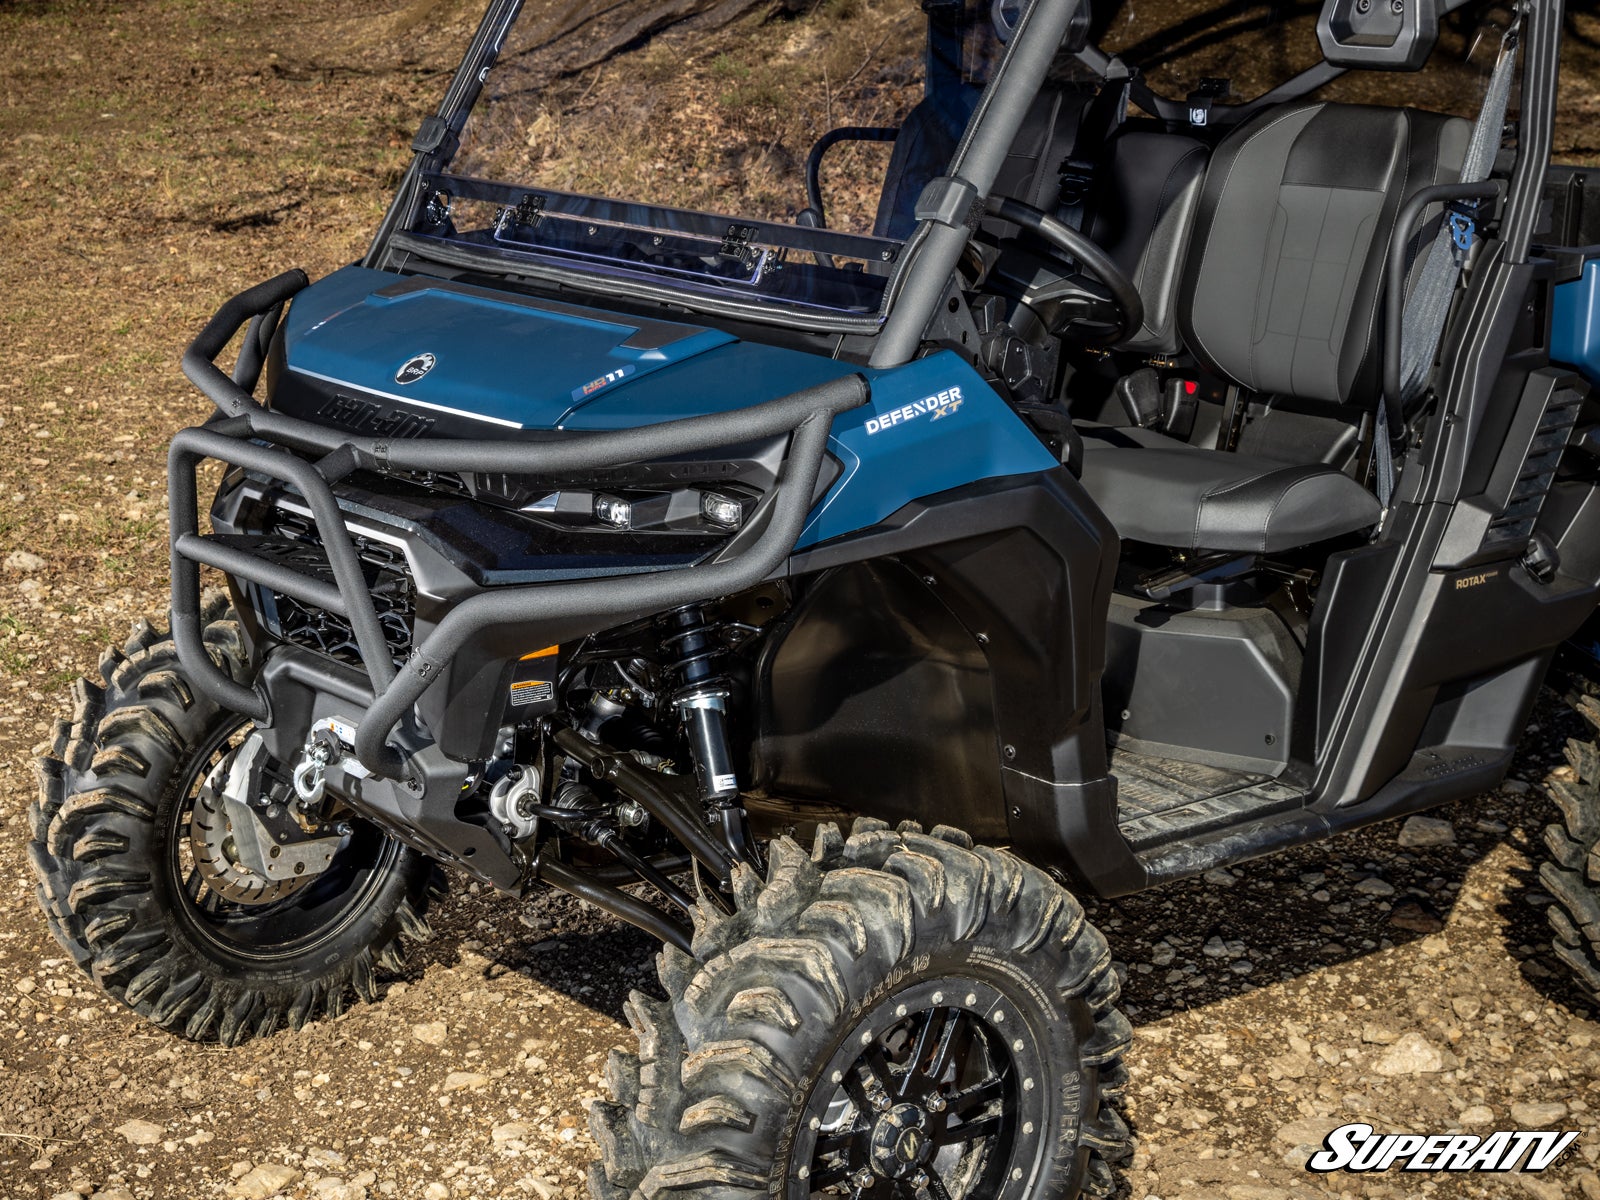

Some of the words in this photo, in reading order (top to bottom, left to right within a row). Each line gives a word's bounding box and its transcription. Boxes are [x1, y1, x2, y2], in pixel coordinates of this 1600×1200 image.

[406, 366, 424, 376] BRP
[865, 386, 962, 435] DEFENDER
[933, 399, 962, 420] XT
[1456, 574, 1487, 590] ROTAX
